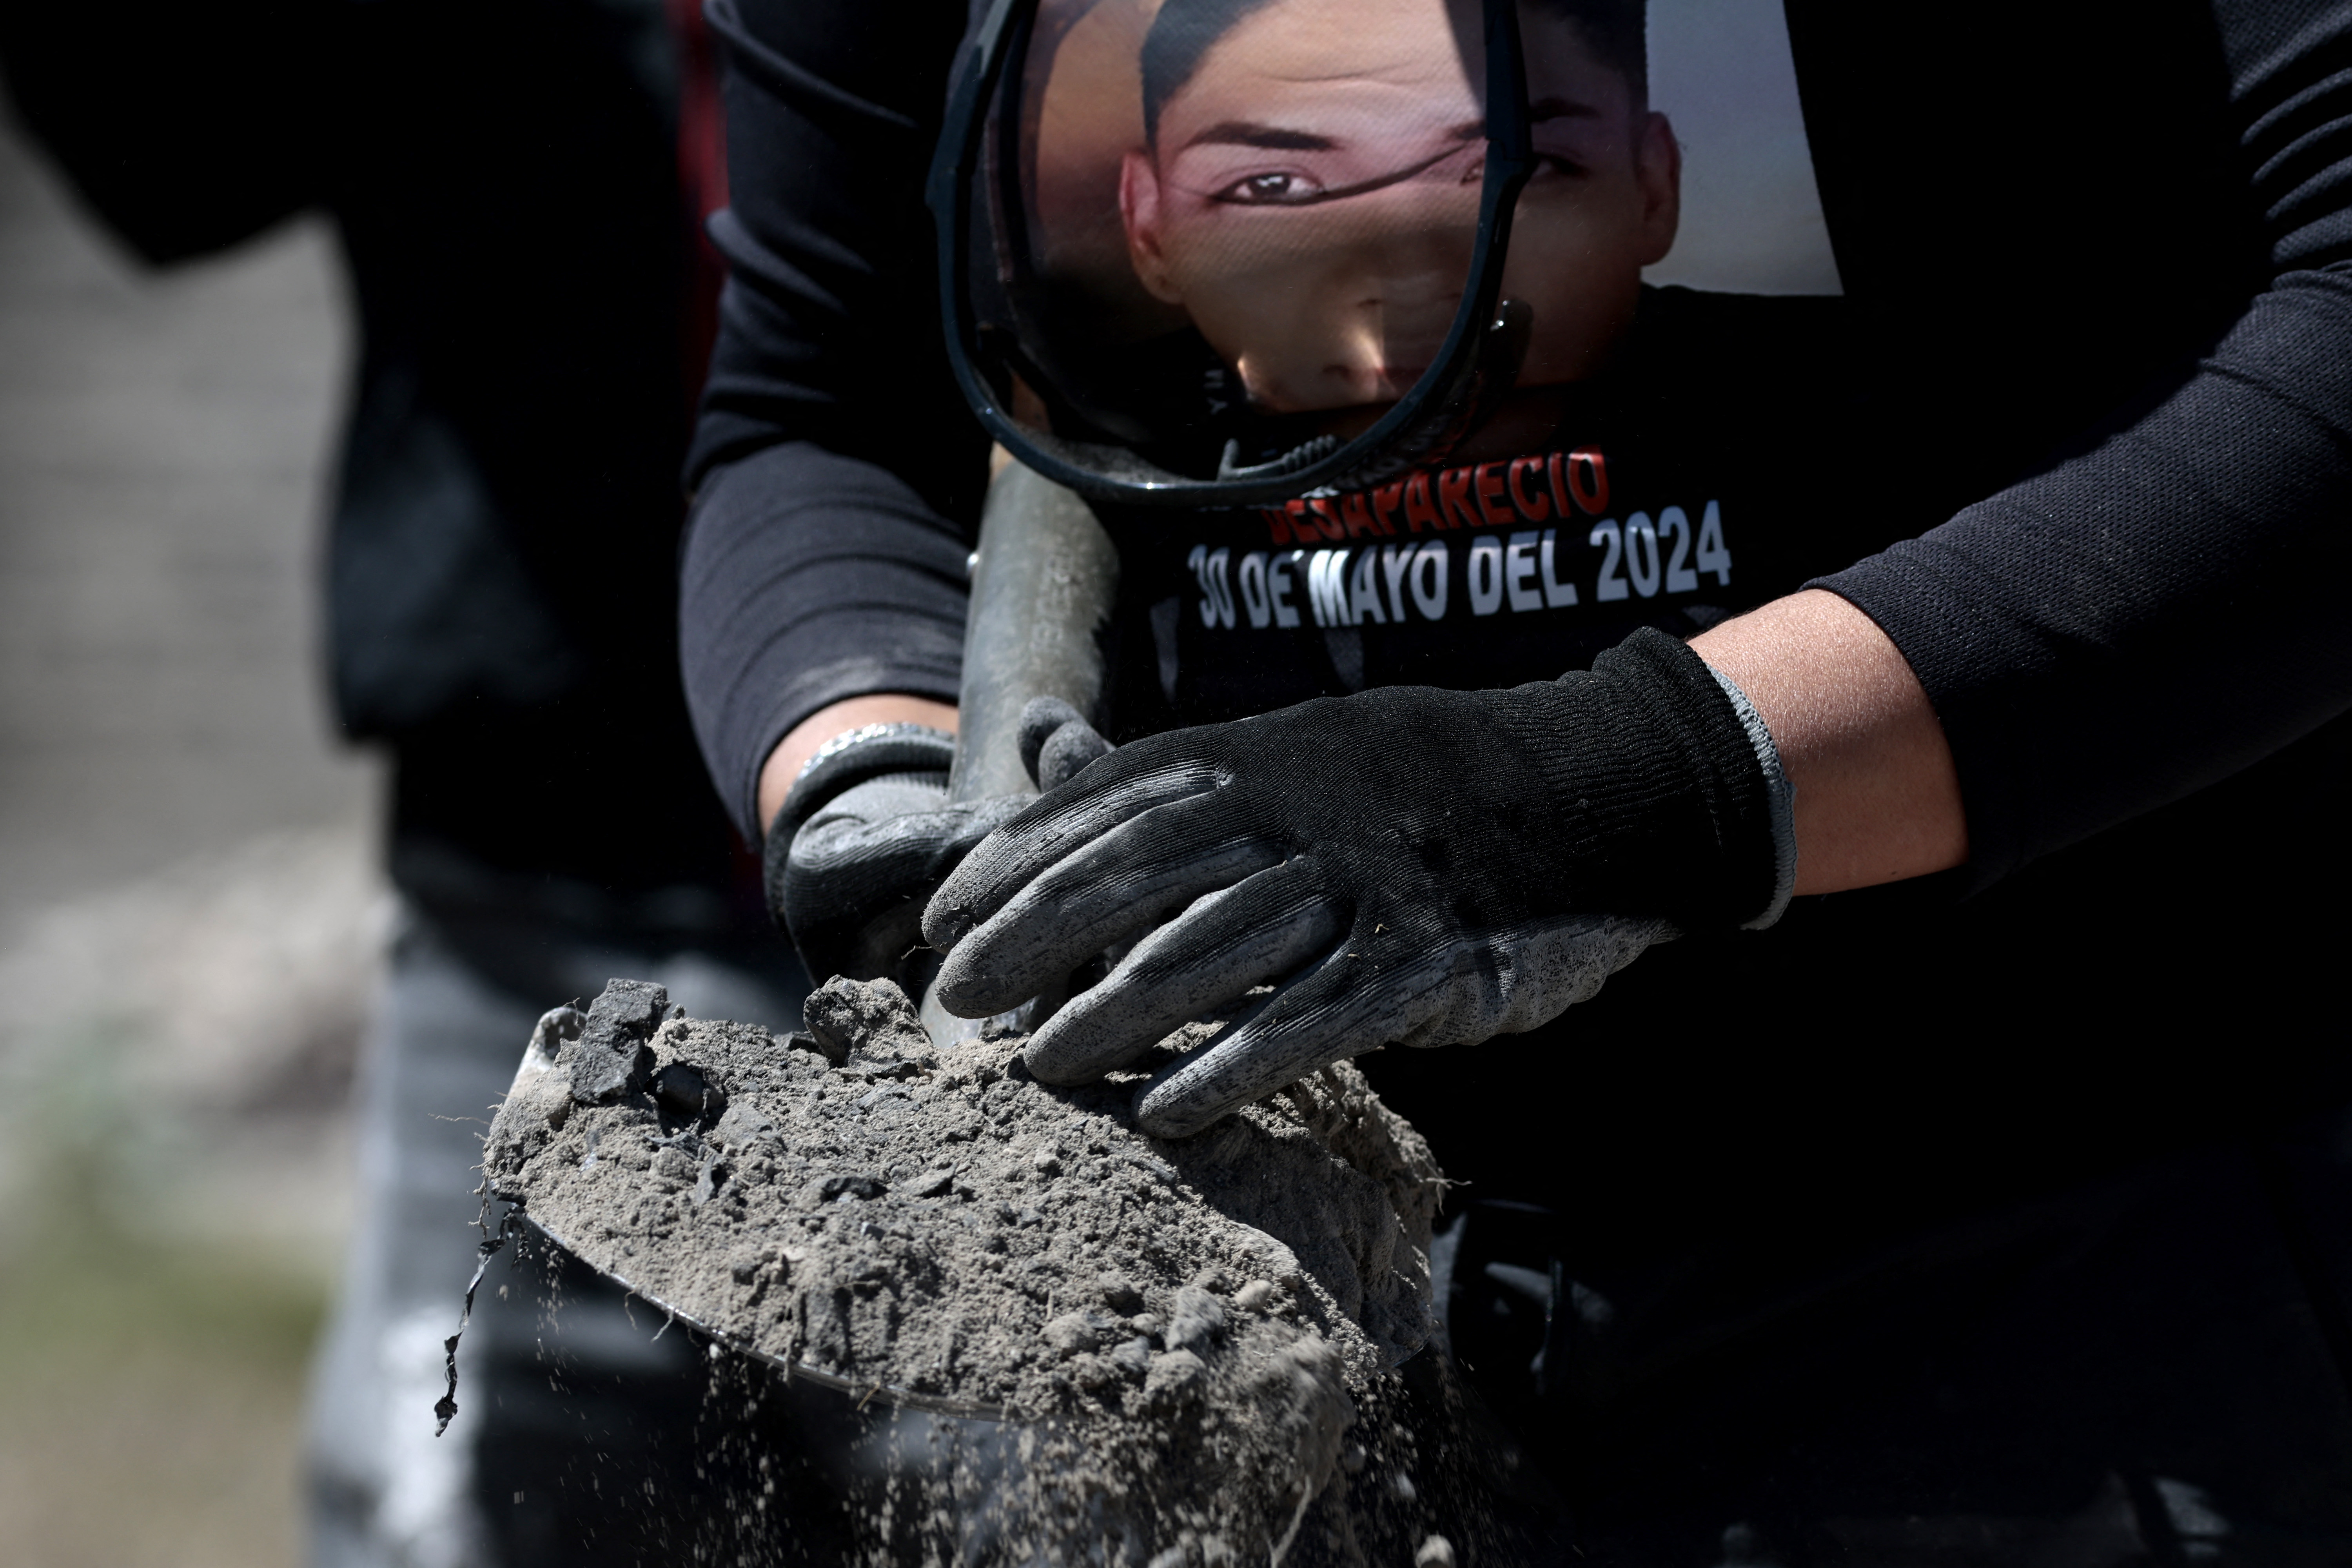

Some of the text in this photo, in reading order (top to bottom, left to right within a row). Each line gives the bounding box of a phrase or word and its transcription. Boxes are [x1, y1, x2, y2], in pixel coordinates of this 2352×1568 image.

[1260, 443, 1610, 545] DESAPARECIO
[1186, 499, 1733, 630] 30 DE MAYO DEL 2024
